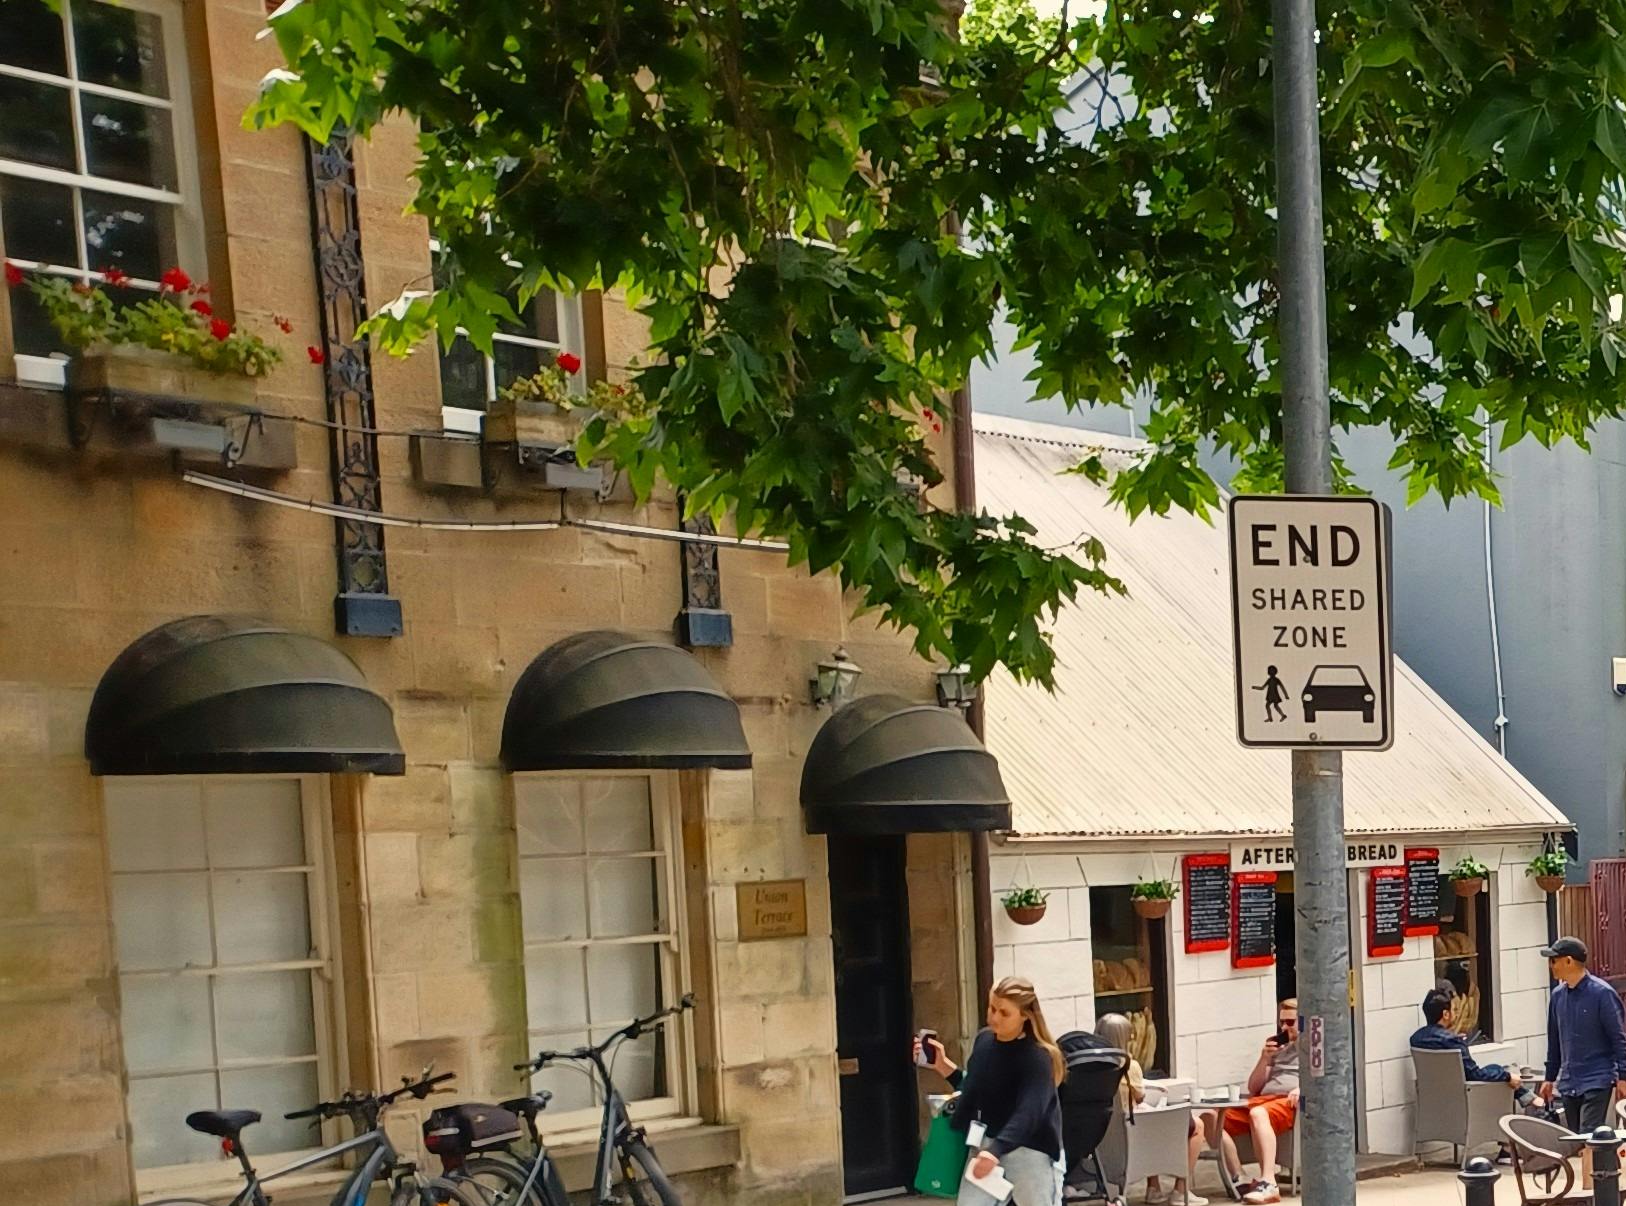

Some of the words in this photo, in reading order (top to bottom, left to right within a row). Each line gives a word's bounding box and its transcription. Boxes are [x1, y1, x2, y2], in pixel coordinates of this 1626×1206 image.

[1251, 524, 1361, 567] END
[1251, 588, 1366, 611] SHARED
[1273, 626, 1348, 649] ZONE
[1242, 848, 1295, 865] AFTER
[1347, 845, 1398, 861] BREAD
